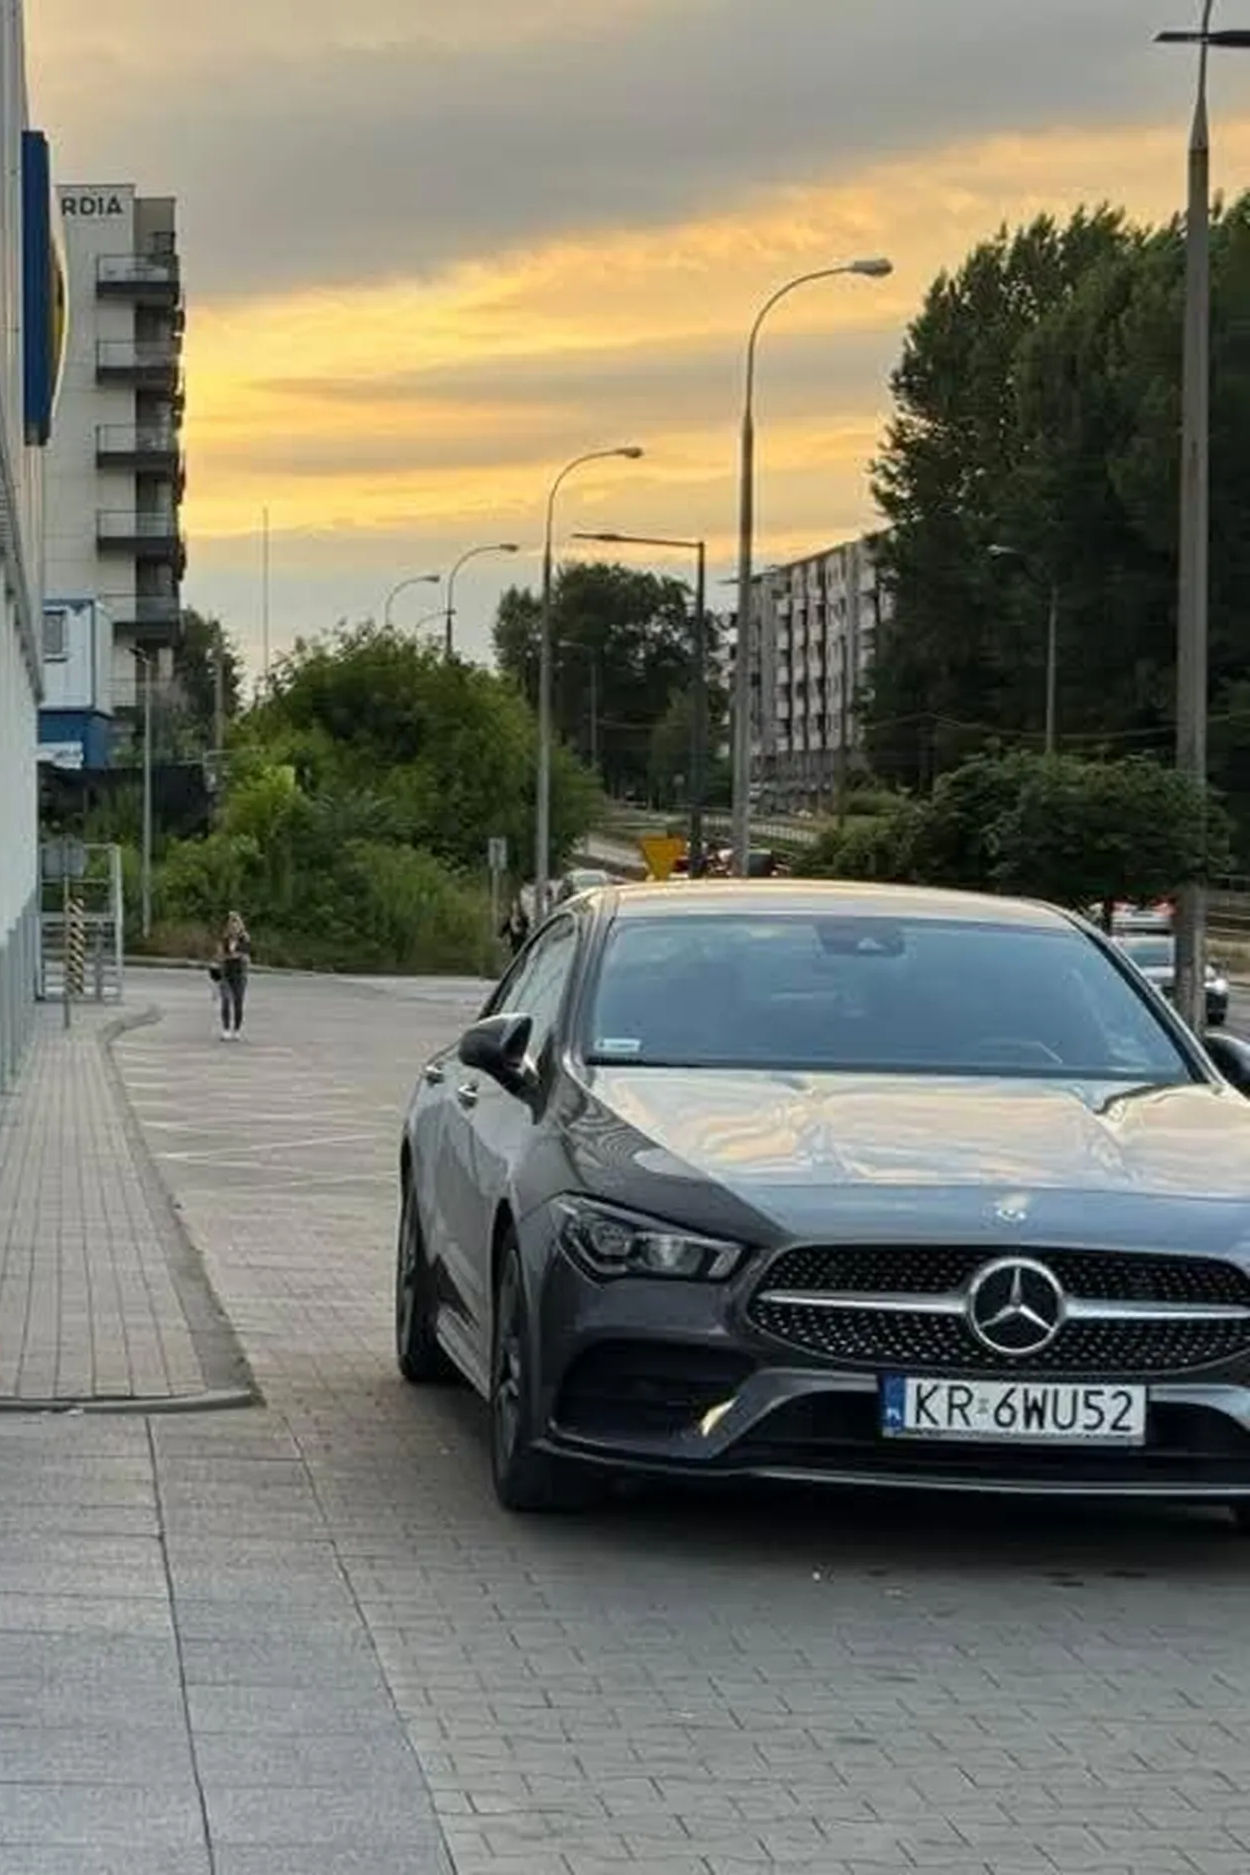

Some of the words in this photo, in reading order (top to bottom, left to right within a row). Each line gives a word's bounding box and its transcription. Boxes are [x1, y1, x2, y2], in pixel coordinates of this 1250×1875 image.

[61, 194, 124, 216] RDIA
[914, 1382, 974, 1428] KR
[993, 1387, 1134, 1432] 6WU52
